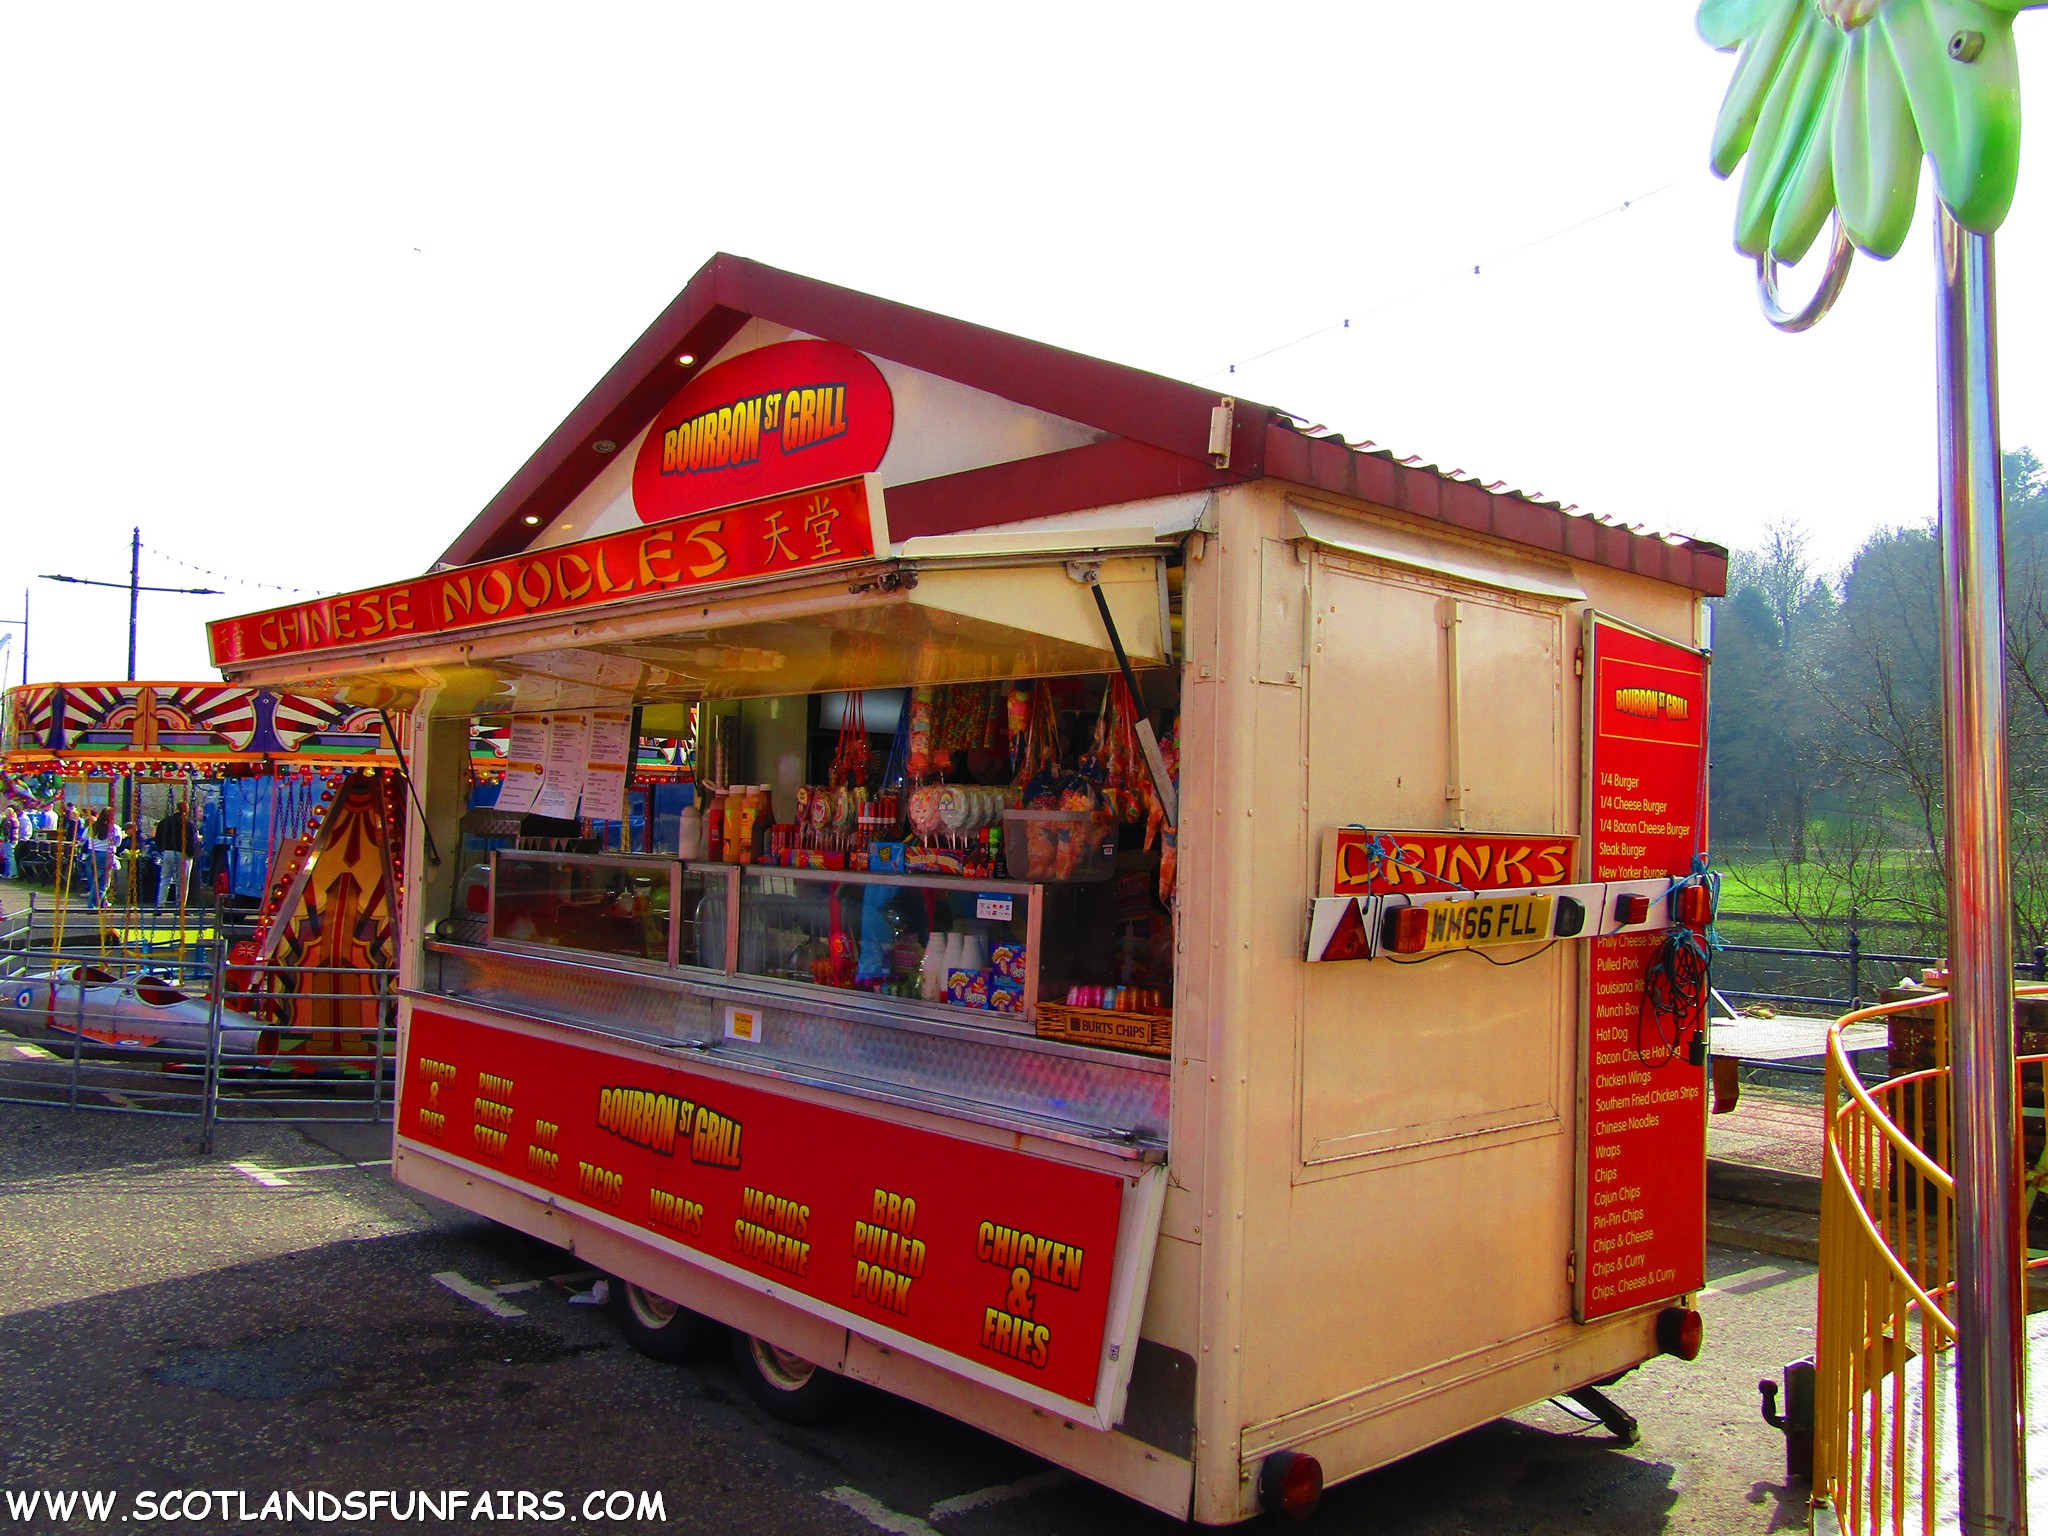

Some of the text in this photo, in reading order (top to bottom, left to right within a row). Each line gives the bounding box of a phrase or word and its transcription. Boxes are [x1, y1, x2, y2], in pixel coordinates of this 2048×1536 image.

[661, 386, 847, 474] BOURBON ST GRILL
[763, 496, 842, 566] 天堂
[259, 519, 729, 651] CHINESE NOODLES
[1615, 687, 1689, 720] BOURBON ST GRILL
[1600, 772, 1639, 791] 1/4 Burger
[1600, 795, 1667, 815] 1/4 Cheese Burger
[1600, 818, 1690, 838] 1/4 Bacon Cheese Burger
[1337, 842, 1566, 886] DRINKS
[1599, 841, 1646, 859] Steak Burger
[1599, 865, 1667, 878] New Yorker Burger
[1496, 902, 1536, 938] FLL
[1597, 935, 1617, 951] Philly
[1618, 934, 1647, 948] Cheese
[1597, 955, 1639, 971] Pulled Pork
[1596, 980, 1633, 995] Louisiana
[1596, 1002, 1640, 1018] Munch Box
[1082, 1020, 1145, 1039] BURTS CHIPS
[1596, 1026, 1628, 1042] Hot Dog
[1596, 1051, 1621, 1065] Bacon
[1651, 1046, 1666, 1058] Hot
[419, 1057, 457, 1090] BURGER
[479, 1072, 514, 1103] PHILLY
[1595, 1070, 1651, 1088] Chicken Wings
[1595, 1086, 1699, 1112] Southern Fried Chicken Strips
[418, 1108, 446, 1137] FRIES
[474, 1097, 514, 1132] CHEESE
[598, 1087, 743, 1168] BOURBON ST GRILL
[1595, 1113, 1659, 1135] Chinese Noodles
[473, 1123, 508, 1159] STEAK
[536, 1118, 560, 1147] HOT
[527, 1144, 560, 1180] DOGS
[1595, 1145, 1621, 1159] Wraps
[578, 1160, 624, 1205] TACOS
[1594, 1168, 1617, 1183] Chips
[650, 1187, 704, 1236] WRAPS
[1594, 1186, 1640, 1207] Cajun Chips
[741, 1186, 810, 1239] NACHOS
[871, 1188, 917, 1240] BBQ
[1593, 1208, 1644, 1230] Piri-Piri Chips
[733, 1218, 811, 1277] SUPREME
[852, 1220, 927, 1279] PULLED
[976, 1220, 1084, 1291] CHICKEN
[1593, 1229, 1654, 1254] Chips & Cheese
[1592, 1254, 1646, 1277] Chips & Curry
[853, 1259, 912, 1316] PORK
[1006, 1267, 1035, 1319] &
[1591, 1268, 1676, 1301] Chips, Cheese & Curry
[981, 1306, 1050, 1369] FRIES
